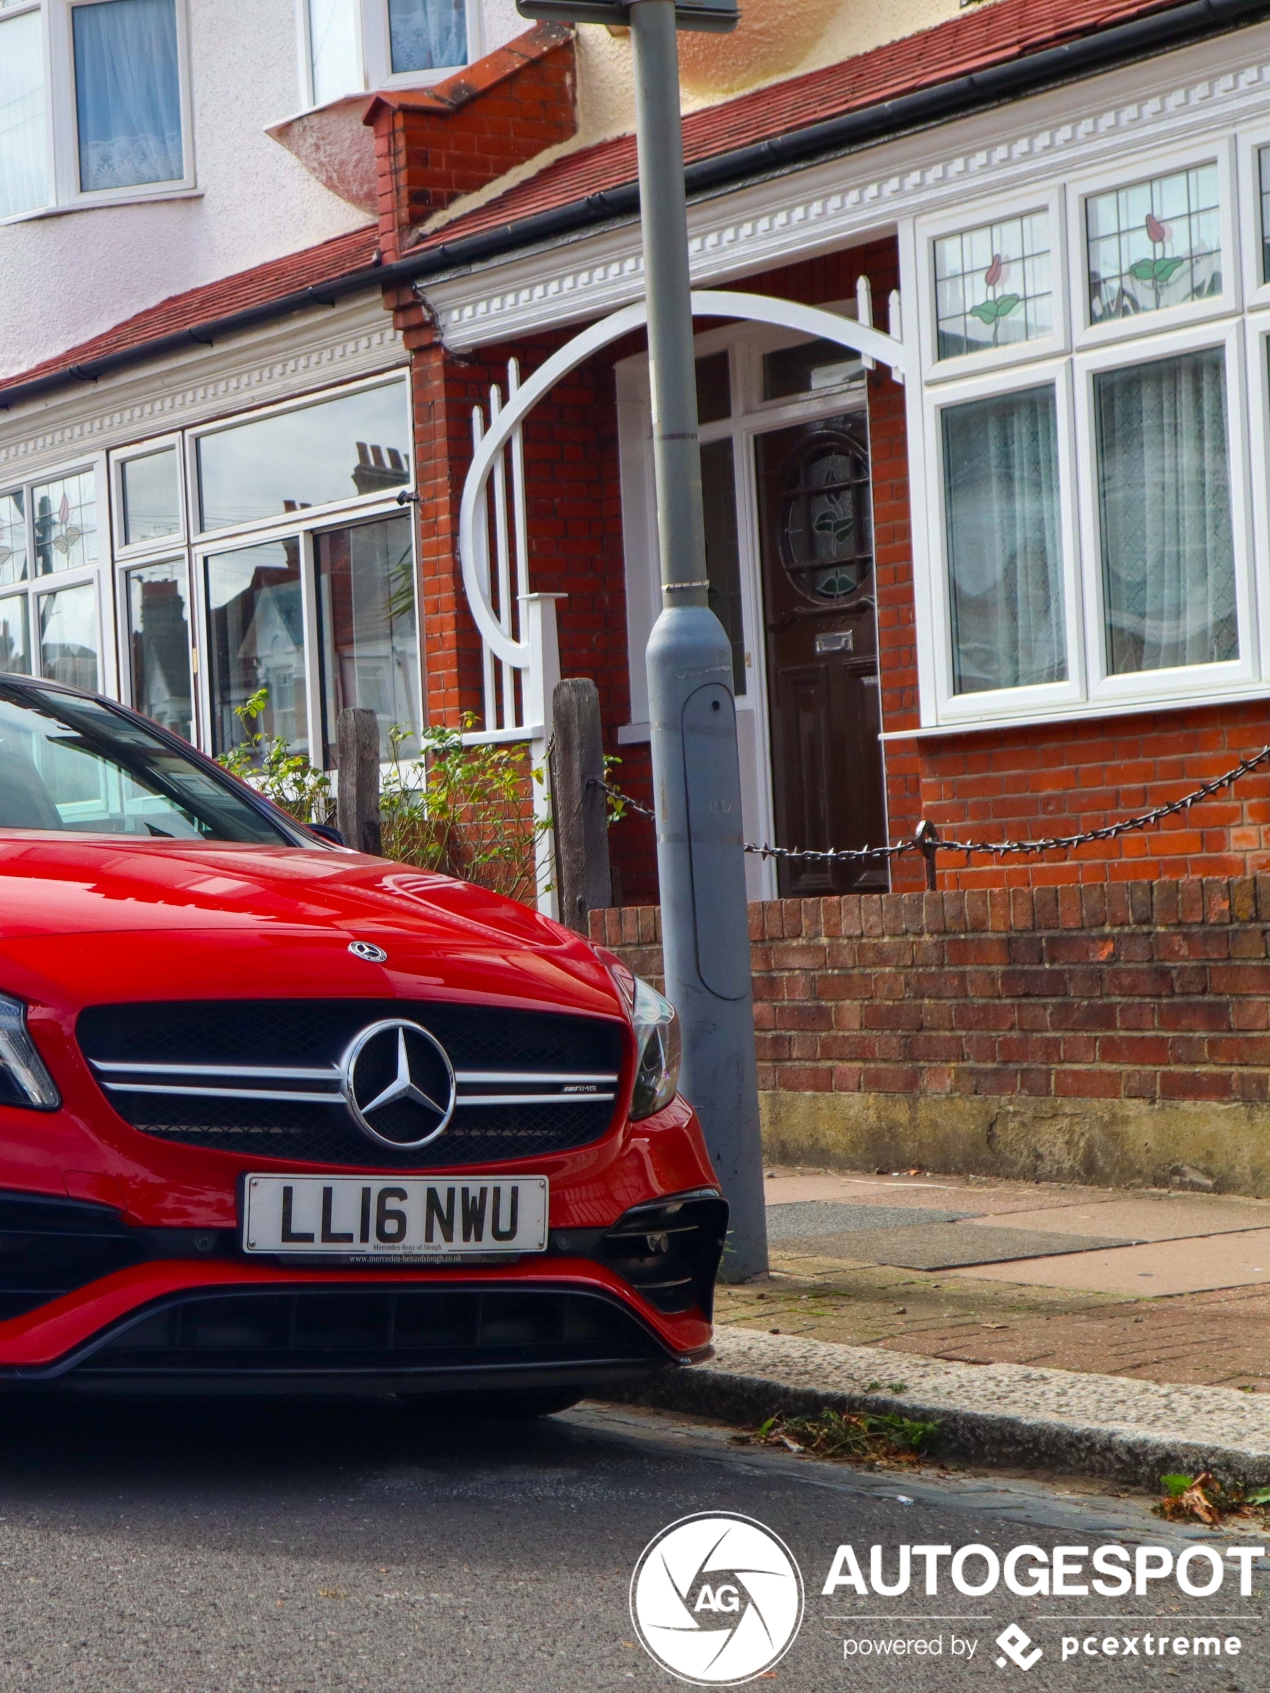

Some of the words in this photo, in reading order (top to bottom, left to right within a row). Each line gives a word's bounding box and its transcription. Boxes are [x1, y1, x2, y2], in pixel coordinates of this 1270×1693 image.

[281, 1186, 408, 1244] LL16
[424, 1186, 519, 1244] NWU
[423, 1243, 442, 1252] Slough
[349, 1254, 462, 1264] www.mercedes-benzofslough.co.uk
